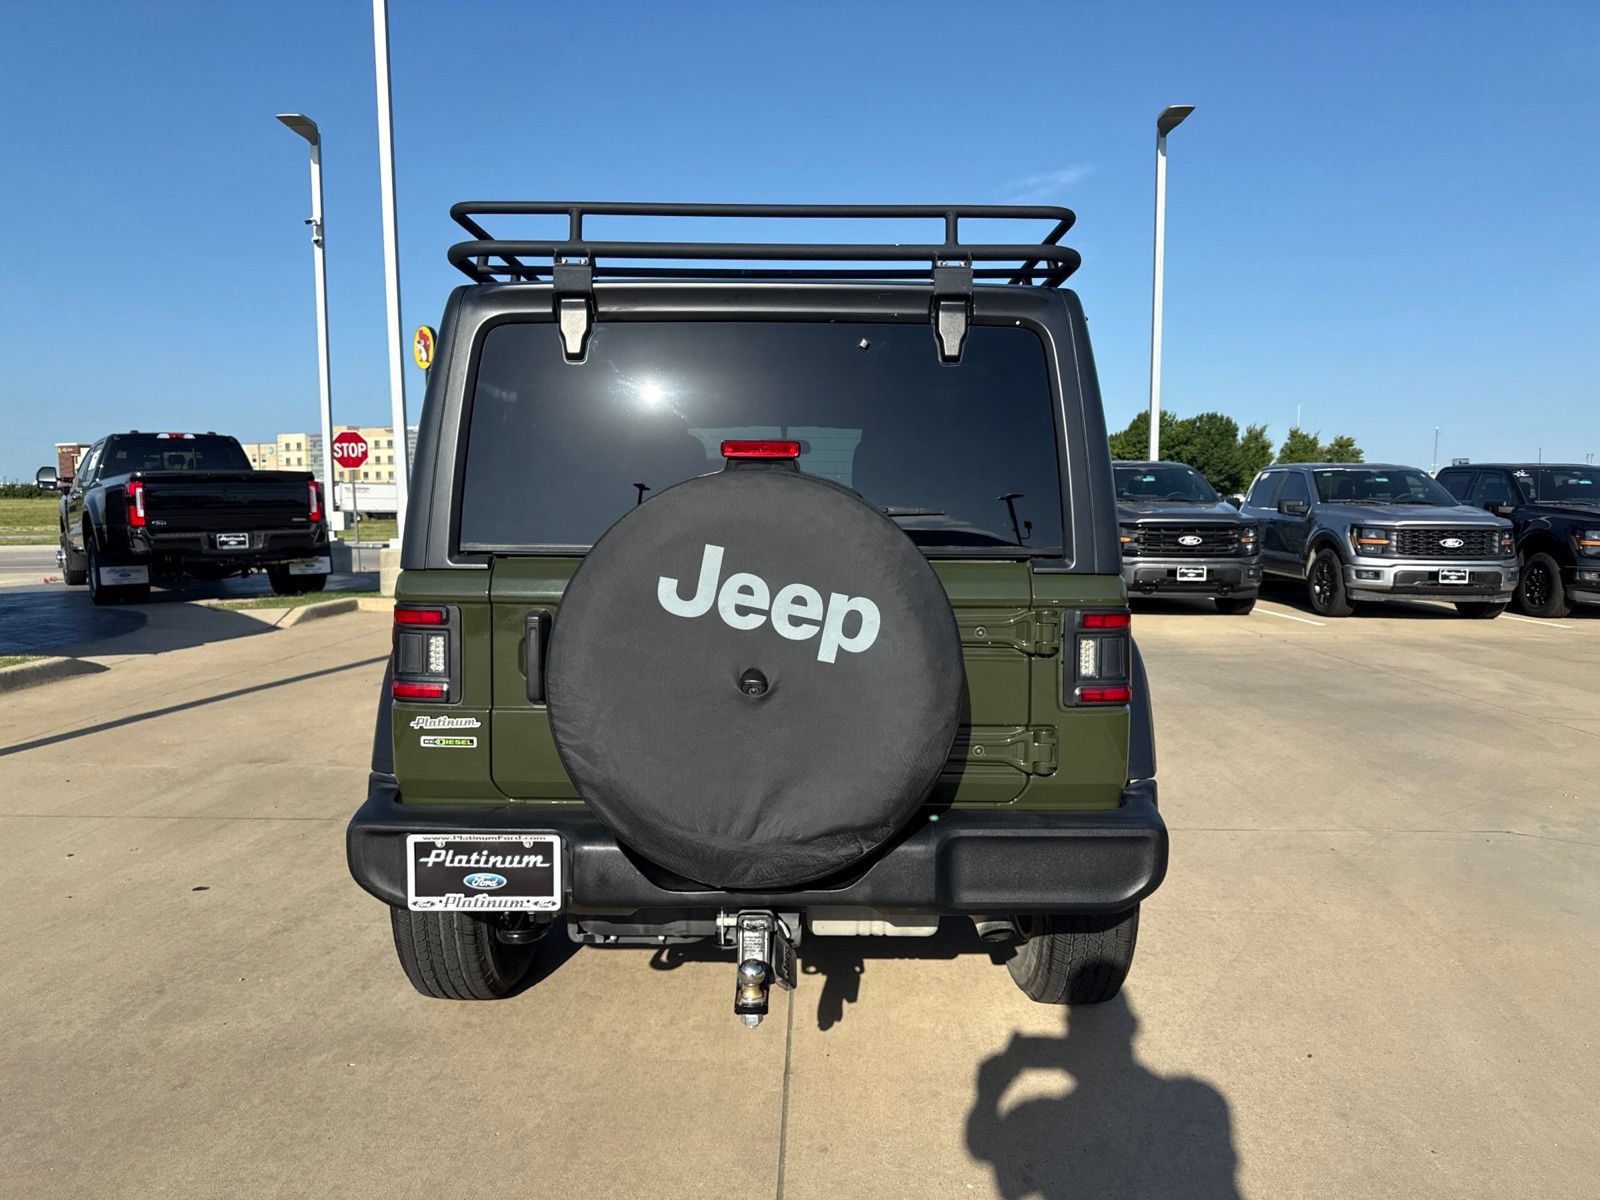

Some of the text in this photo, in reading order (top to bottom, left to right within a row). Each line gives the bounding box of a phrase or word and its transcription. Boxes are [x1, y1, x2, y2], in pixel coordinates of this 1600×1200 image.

[333, 442, 367, 458] STOP
[657, 543, 881, 664] Jeep
[411, 716, 480, 728] Platinum
[419, 850, 551, 868] Platinum
[471, 875, 498, 887] Ford
[444, 895, 530, 908] Platinum
